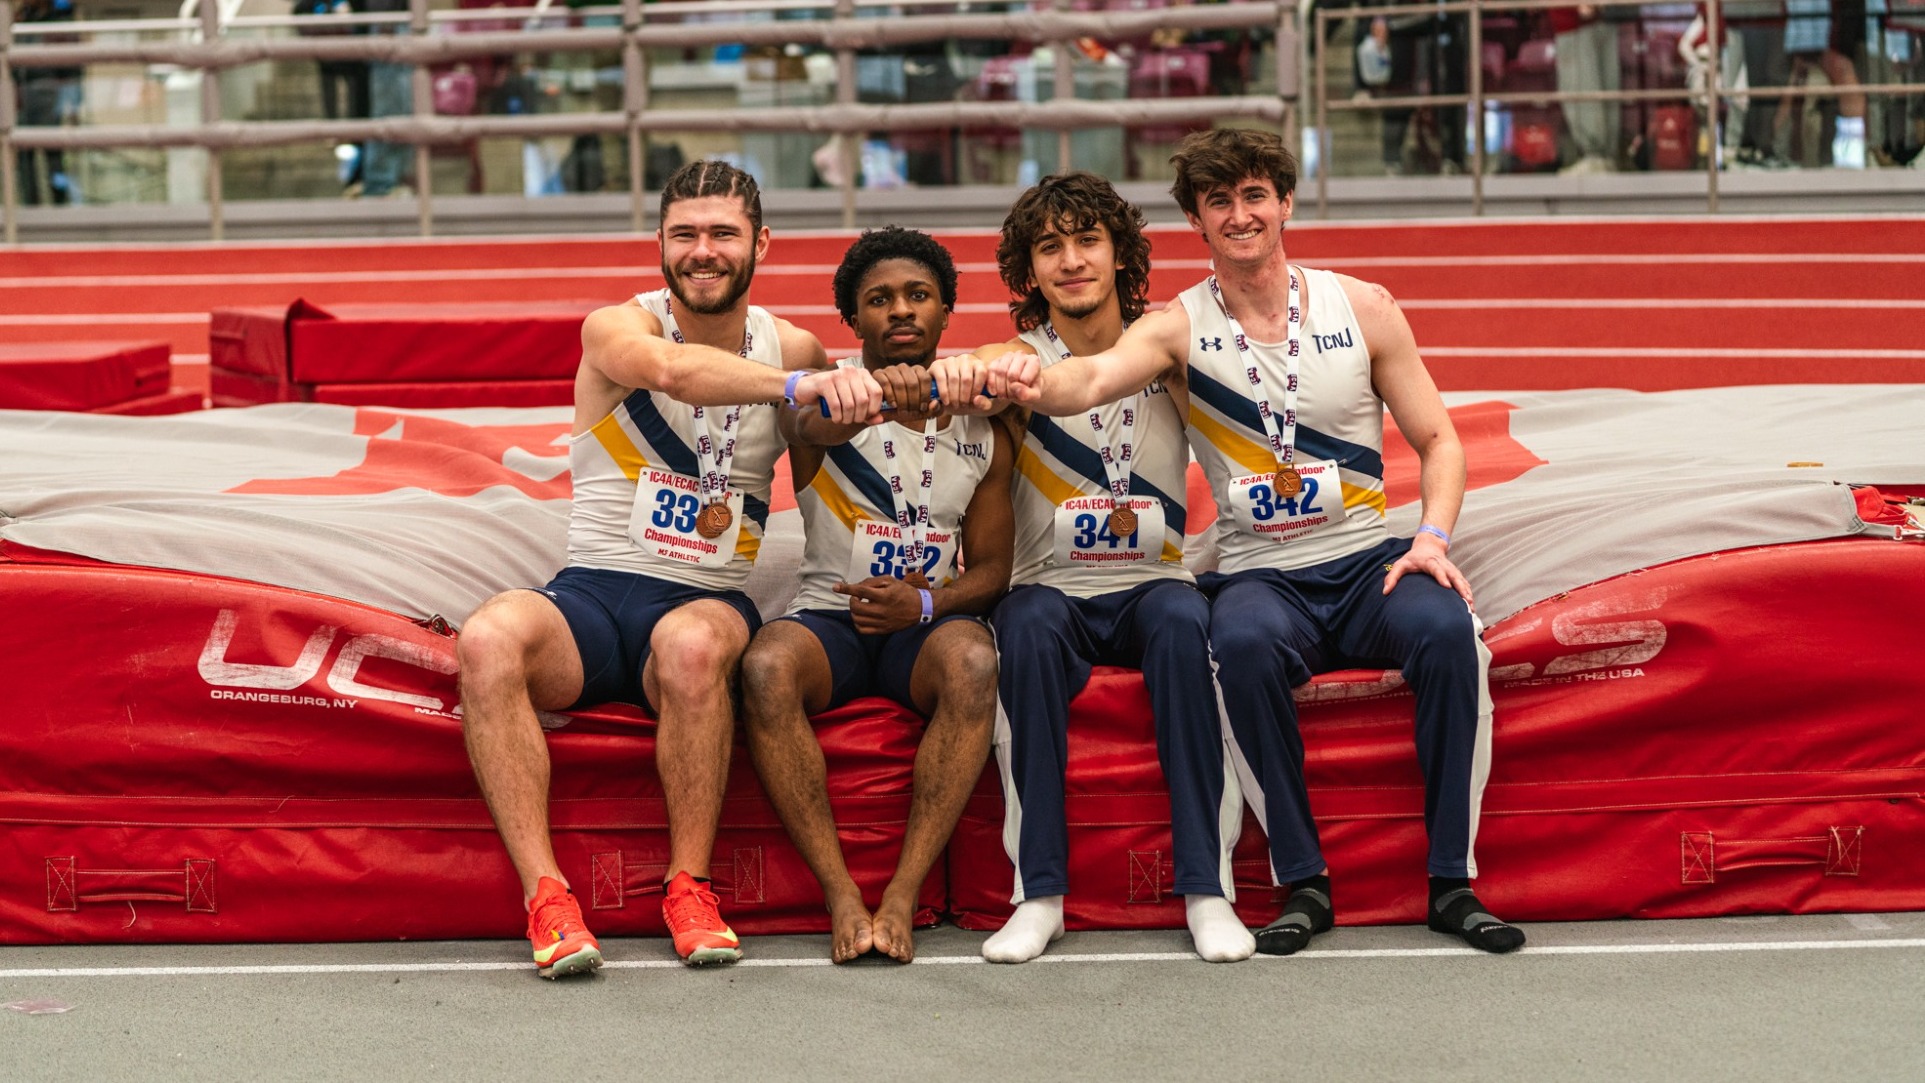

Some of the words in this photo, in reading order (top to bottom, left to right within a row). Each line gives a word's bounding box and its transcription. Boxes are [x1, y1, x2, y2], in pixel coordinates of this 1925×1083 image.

[1312, 327, 1354, 354] TCNJ
[954, 438, 987, 460] TCNJ
[649, 470, 699, 493] IC4A/ECAC
[1297, 466, 1326, 476] ndoor
[1249, 477, 1323, 522] 342
[652, 489, 700, 533] 33
[1074, 513, 1139, 549] 341
[1252, 515, 1329, 534] Championships
[644, 528, 718, 554] Championships
[926, 532, 951, 544] ndoor
[668, 551, 701, 563] ATHLETIC
[1070, 551, 1145, 562] Championships
[198, 608, 466, 714] UC
[1576, 673, 1607, 682] THE
[1609, 667, 1645, 680] USA
[210, 689, 331, 708] ORANGEBURG,
[333, 699, 358, 708] NY
